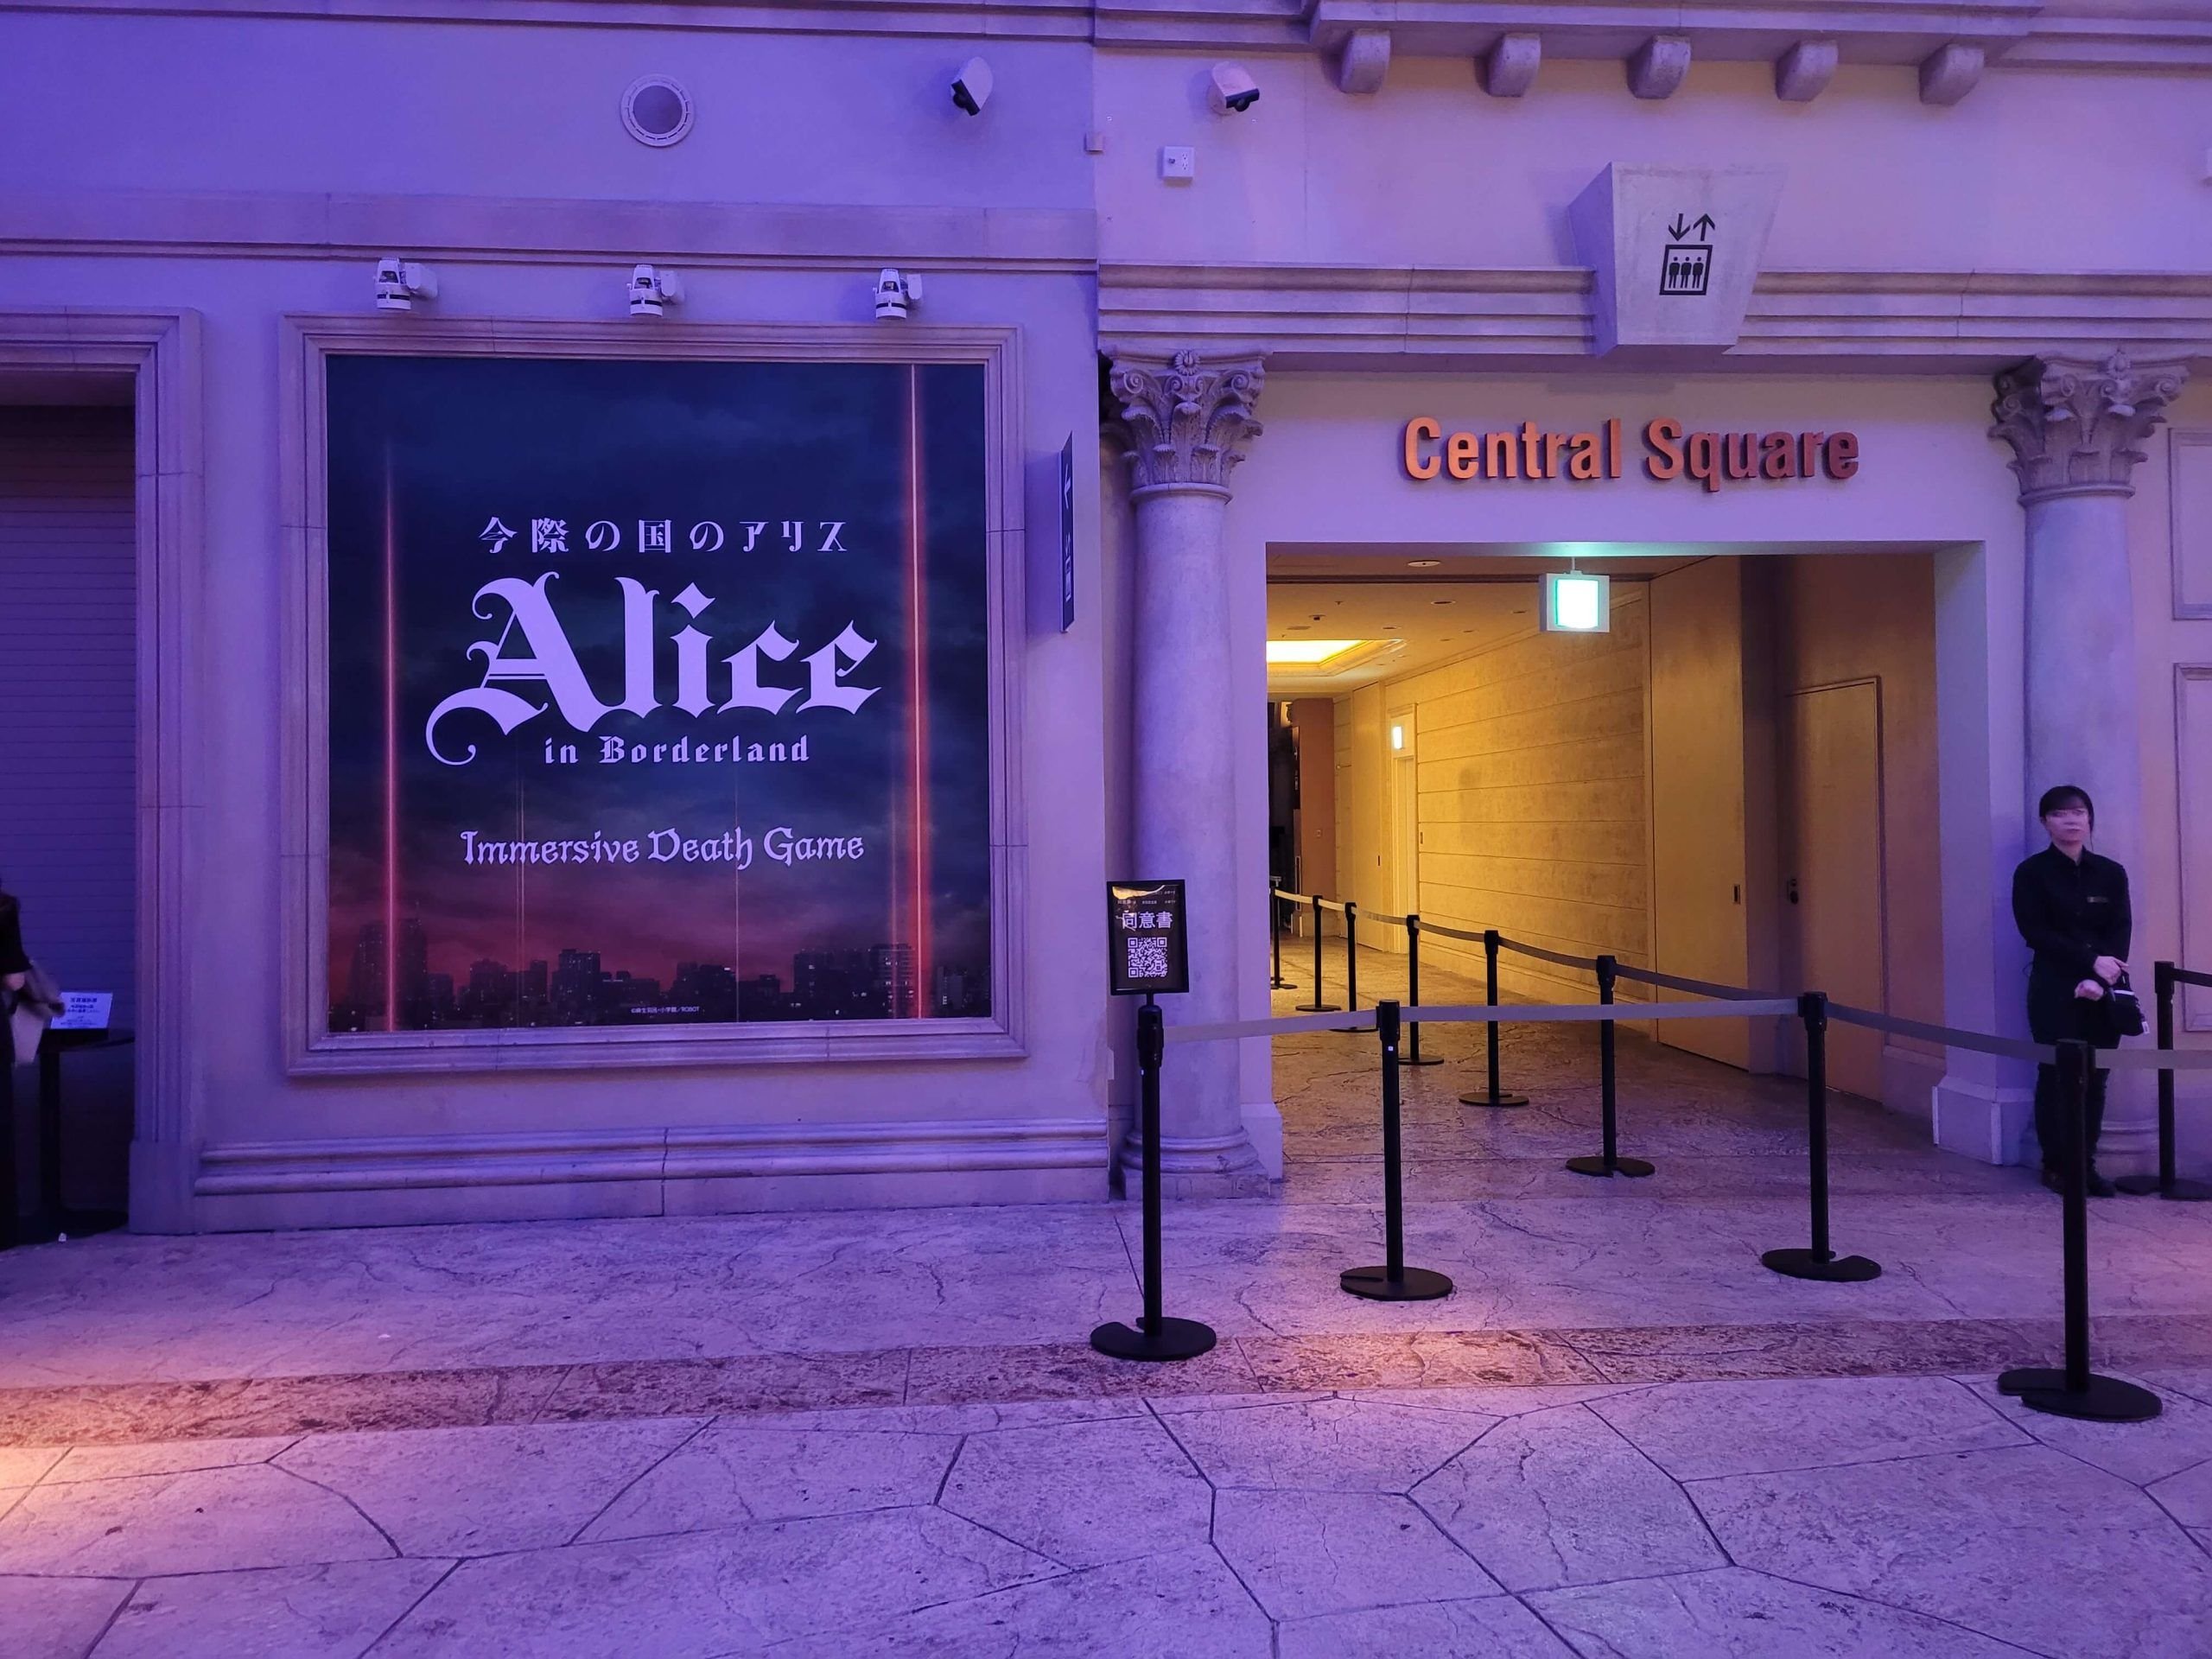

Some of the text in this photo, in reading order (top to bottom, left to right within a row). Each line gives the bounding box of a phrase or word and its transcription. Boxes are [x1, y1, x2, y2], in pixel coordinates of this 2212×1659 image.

[1404, 416, 1860, 493] Central Square
[479, 516, 848, 554] 今際の国のアリス
[425, 571, 882, 766] Alice
[544, 734, 810, 764] in Borderland
[460, 826, 865, 870] Immersive Death Game
[1122, 911, 1173, 929] 同意書
